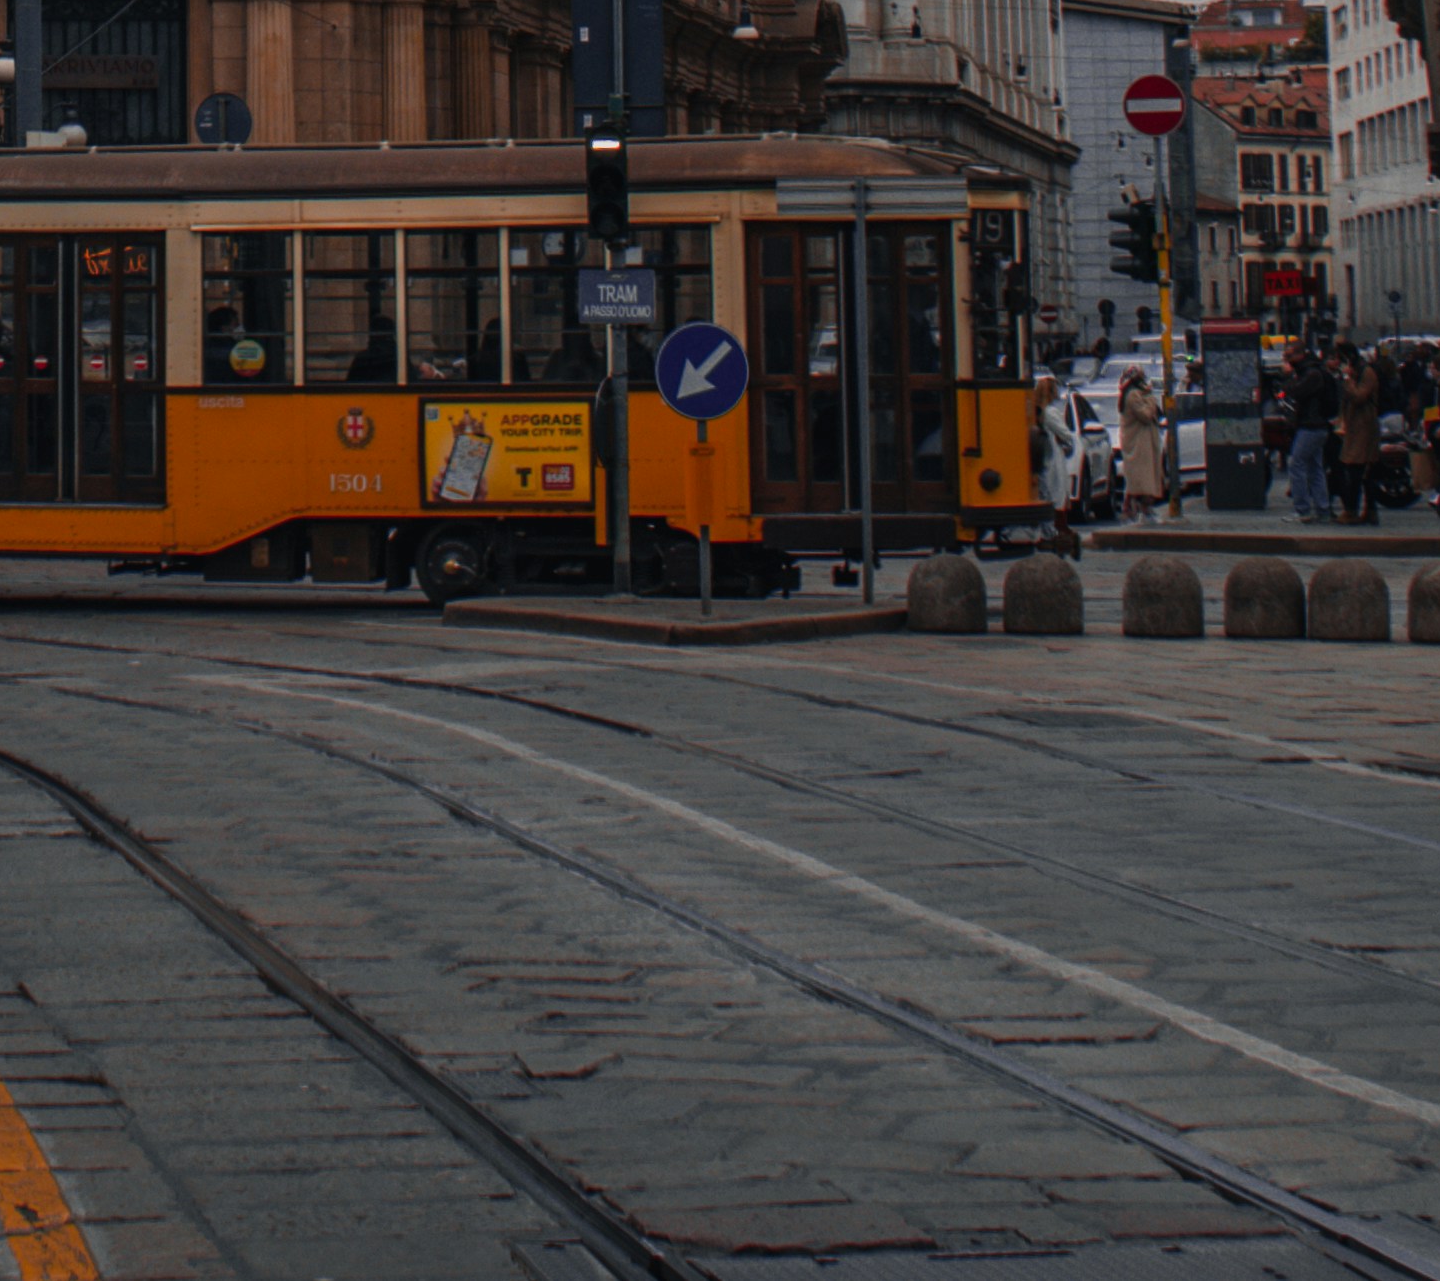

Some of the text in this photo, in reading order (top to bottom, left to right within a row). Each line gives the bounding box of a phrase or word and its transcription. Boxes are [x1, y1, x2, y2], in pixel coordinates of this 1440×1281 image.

[975, 211, 1003, 243] 19
[1264, 277, 1300, 290] TAXI
[596, 284, 638, 303] TRAM
[583, 305, 590, 316] A
[590, 305, 617, 318] PASSO
[198, 396, 246, 409] uscita
[500, 414, 583, 426] APPGRADE
[500, 428, 529, 437] YOUR
[532, 428, 555, 437] CITY
[329, 473, 382, 493] 1504
